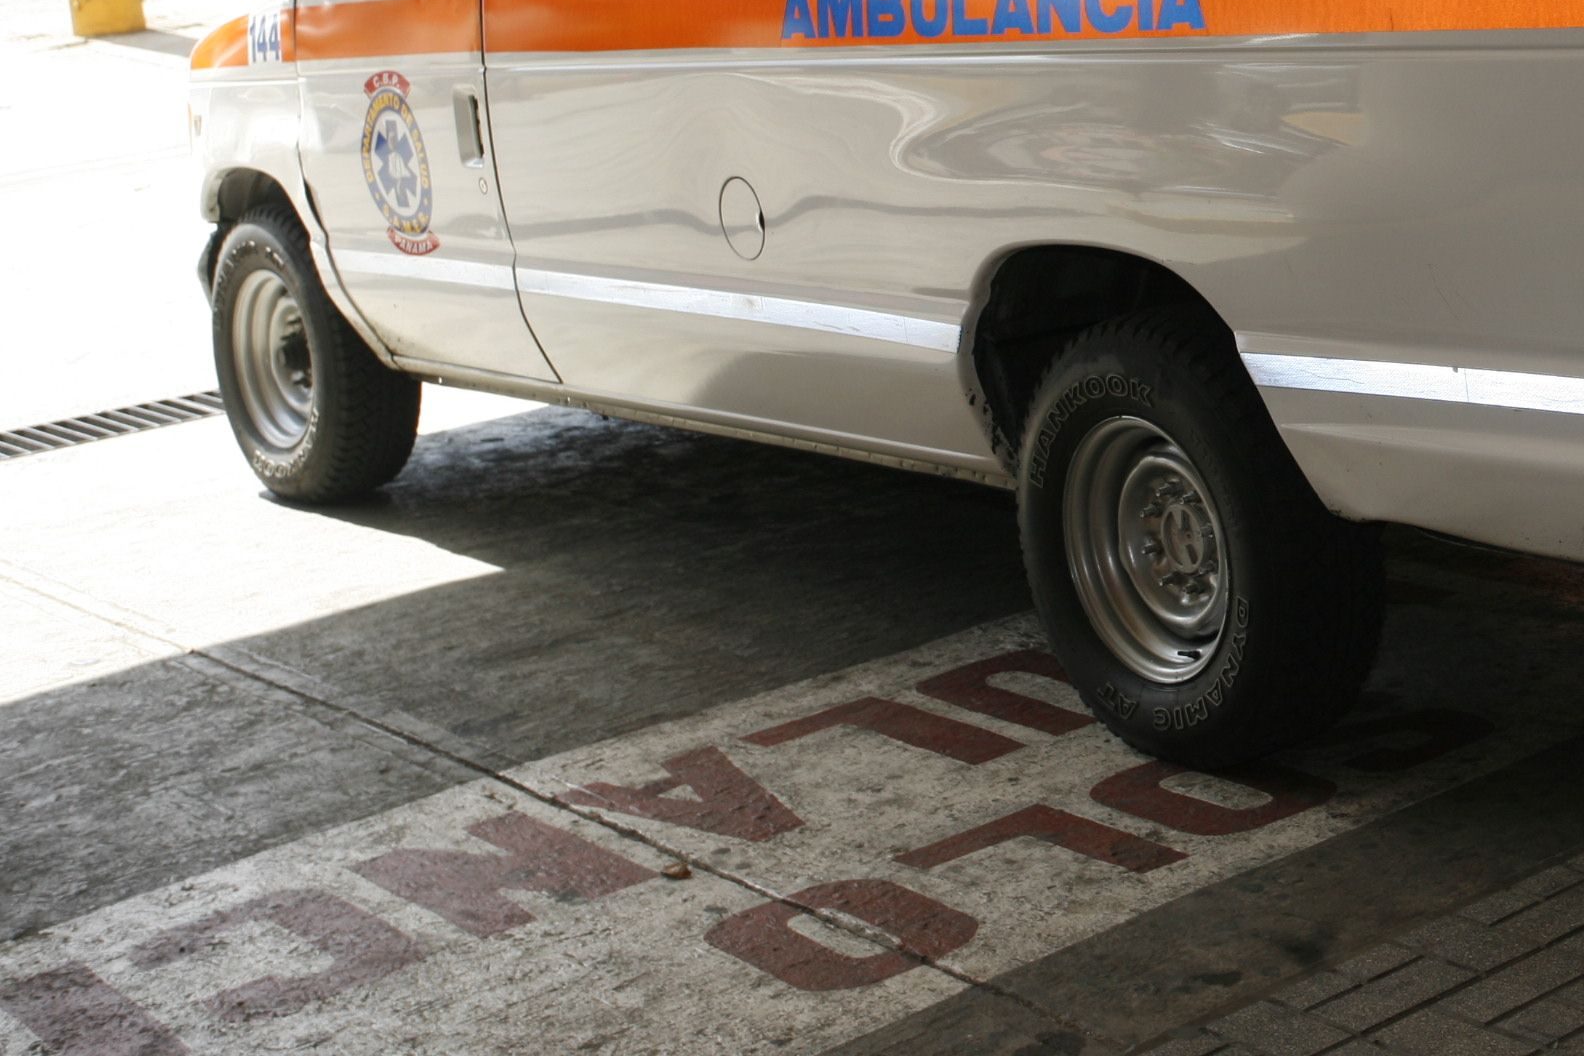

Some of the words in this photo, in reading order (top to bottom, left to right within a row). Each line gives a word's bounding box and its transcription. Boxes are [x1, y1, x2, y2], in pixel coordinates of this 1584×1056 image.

[249, 13, 280, 63] 144
[394, 232, 434, 255] PANAMA
[1029, 373, 1155, 488] HANKOOK
[1152, 595, 1253, 731] DYNAMIC
[1097, 681, 1140, 721] AT
